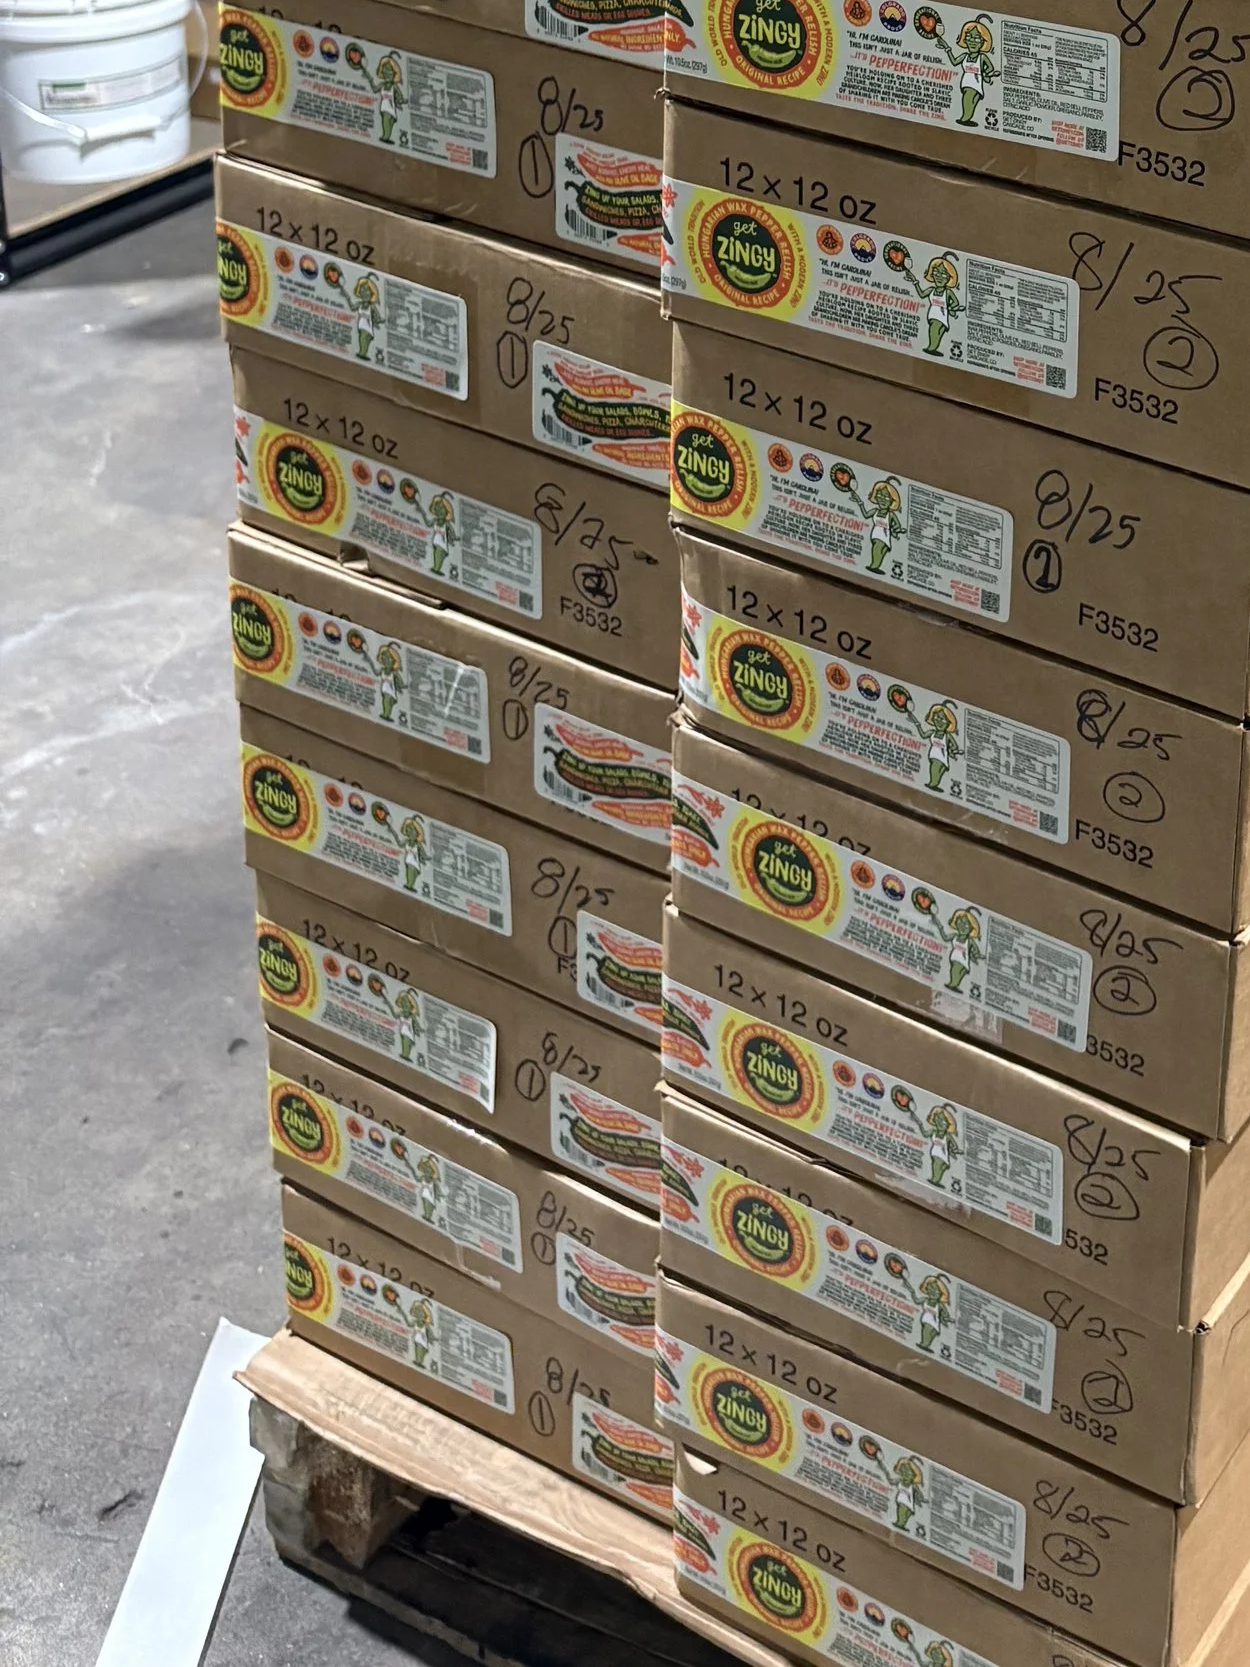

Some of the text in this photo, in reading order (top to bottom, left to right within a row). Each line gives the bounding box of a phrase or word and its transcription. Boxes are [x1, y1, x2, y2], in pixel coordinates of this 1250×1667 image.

[1118, 140, 1205, 187] F3532
[283, 399, 399, 459] 12 x 12 oz
[723, 372, 872, 445] 12 x 12 oz
[561, 596, 623, 637] F3532
[1078, 603, 1159, 653] F3532
